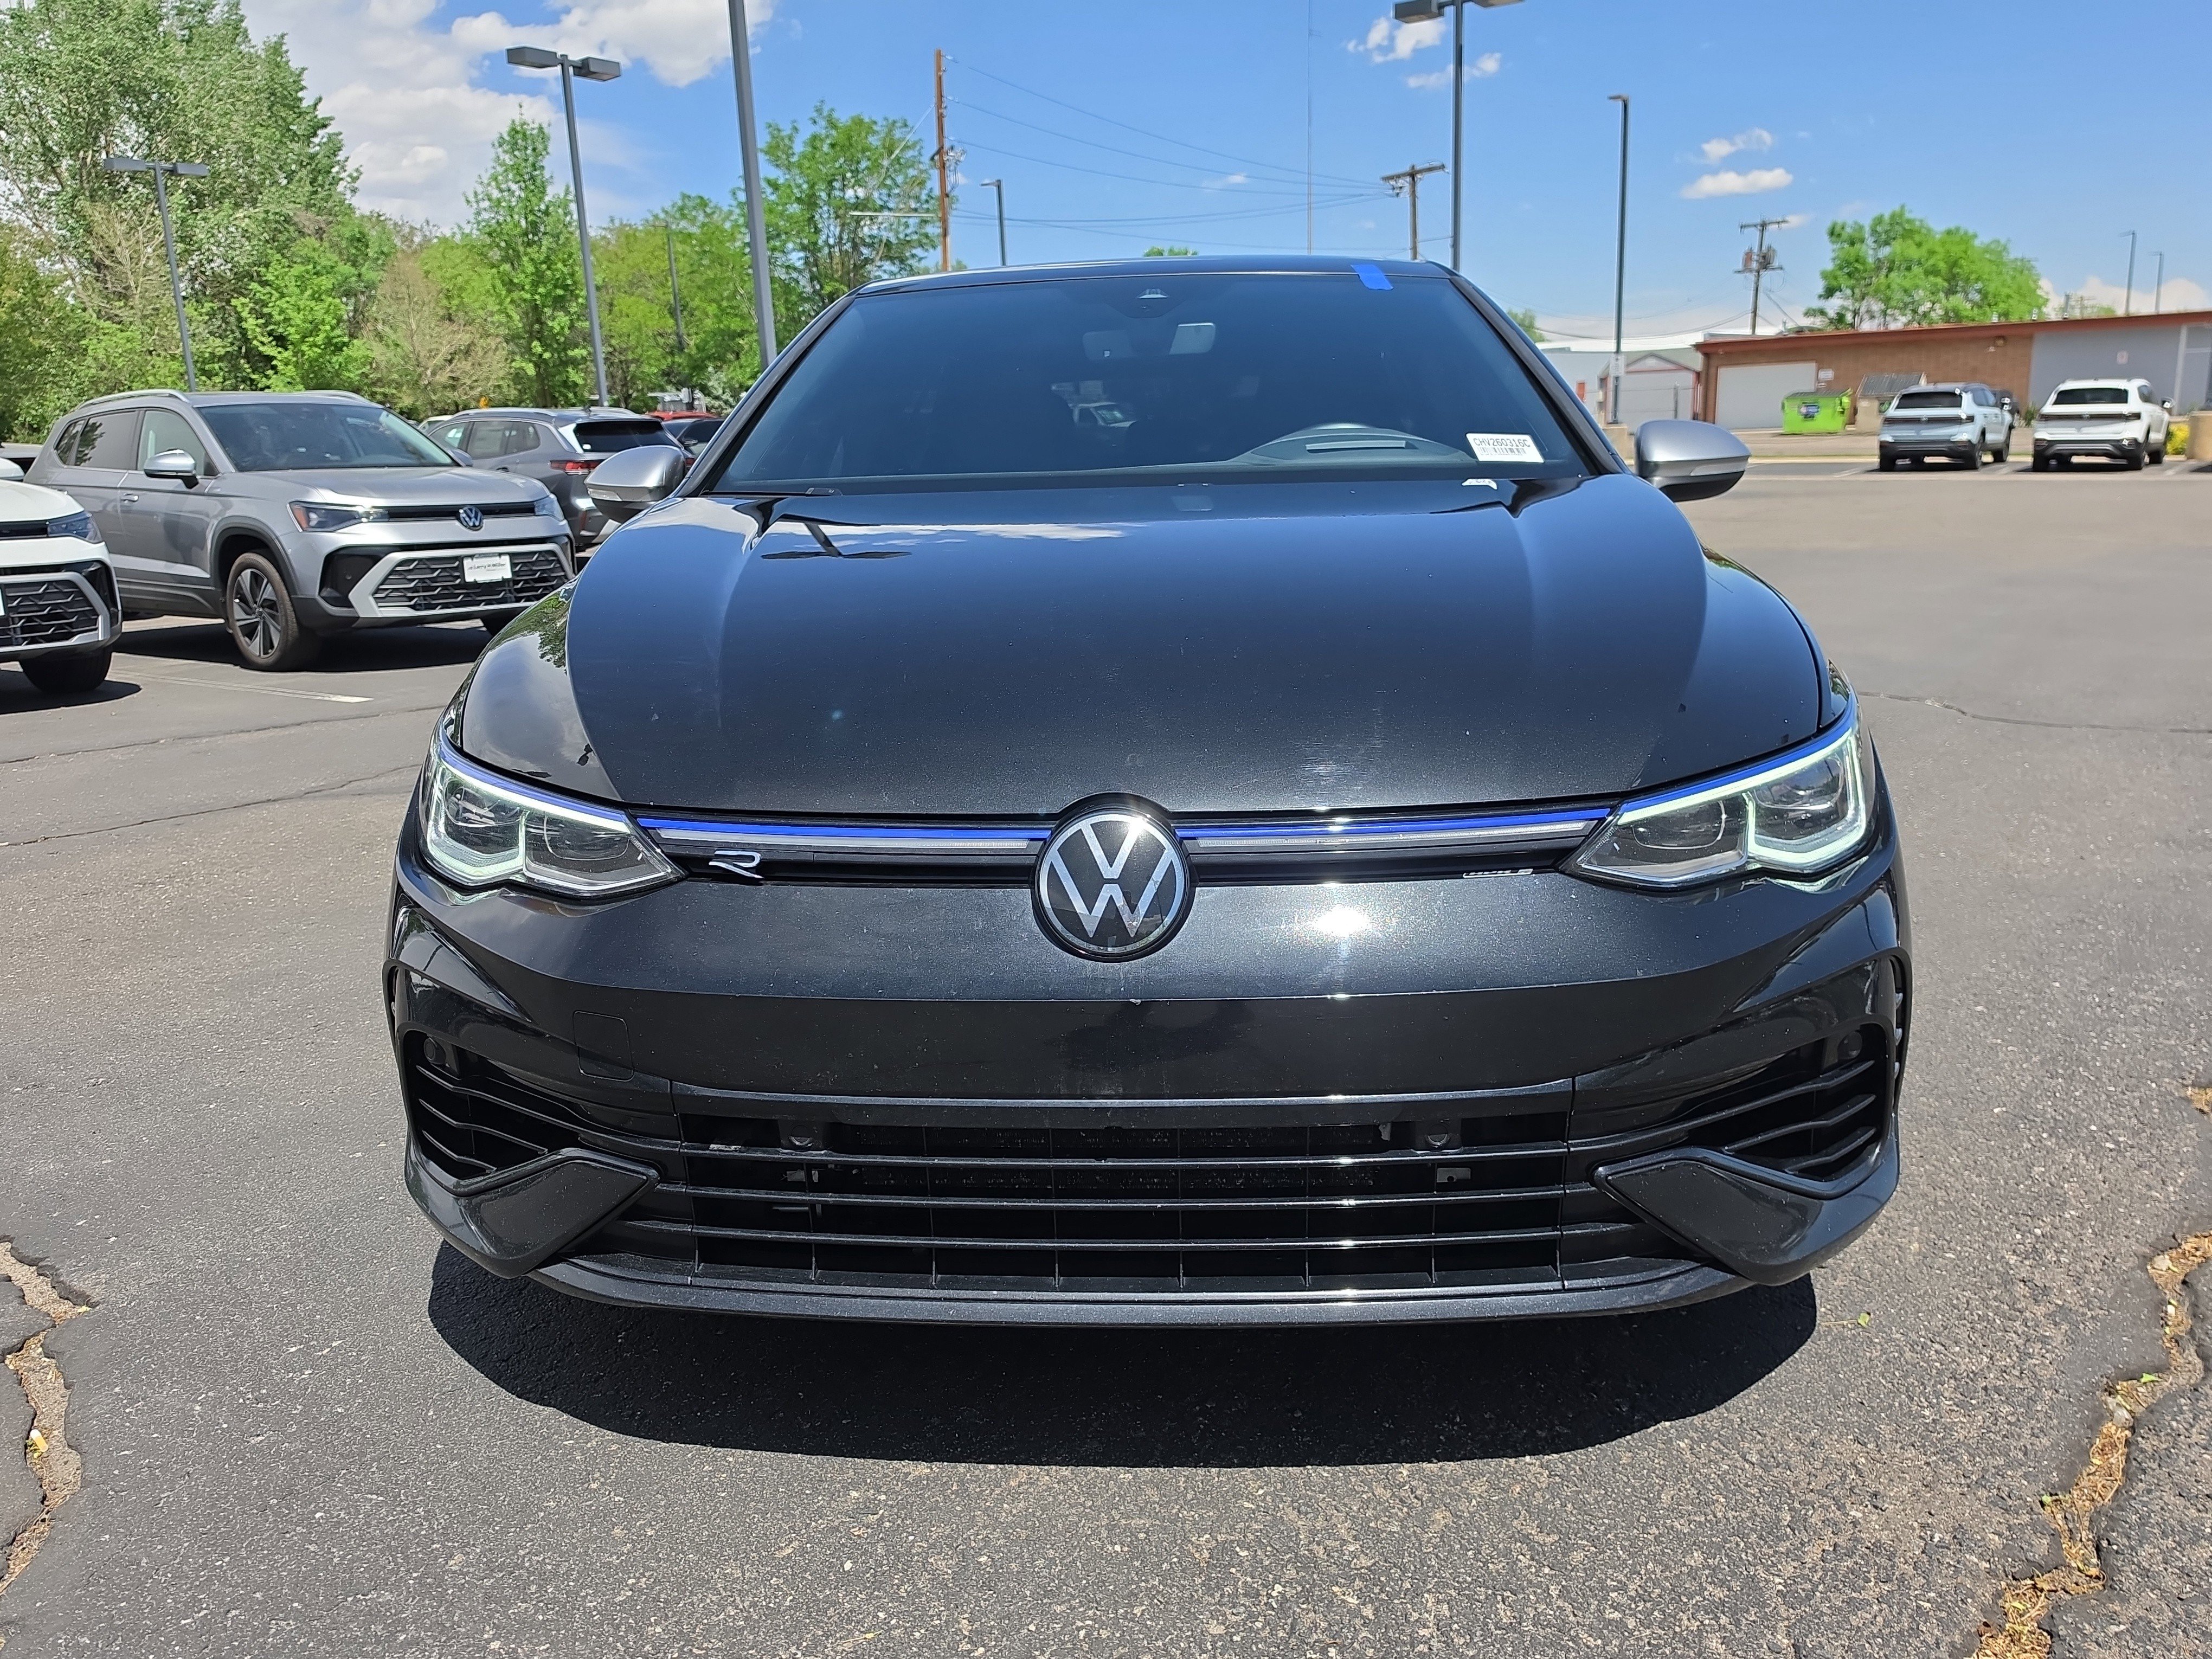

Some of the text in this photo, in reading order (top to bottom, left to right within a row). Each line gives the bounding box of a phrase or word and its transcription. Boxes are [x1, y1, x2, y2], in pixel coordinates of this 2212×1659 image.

[1473, 437, 1531, 447] CHV260316C
[461, 506, 483, 528] VW
[708, 850, 764, 879] R
[1040, 814, 1184, 949] VW
